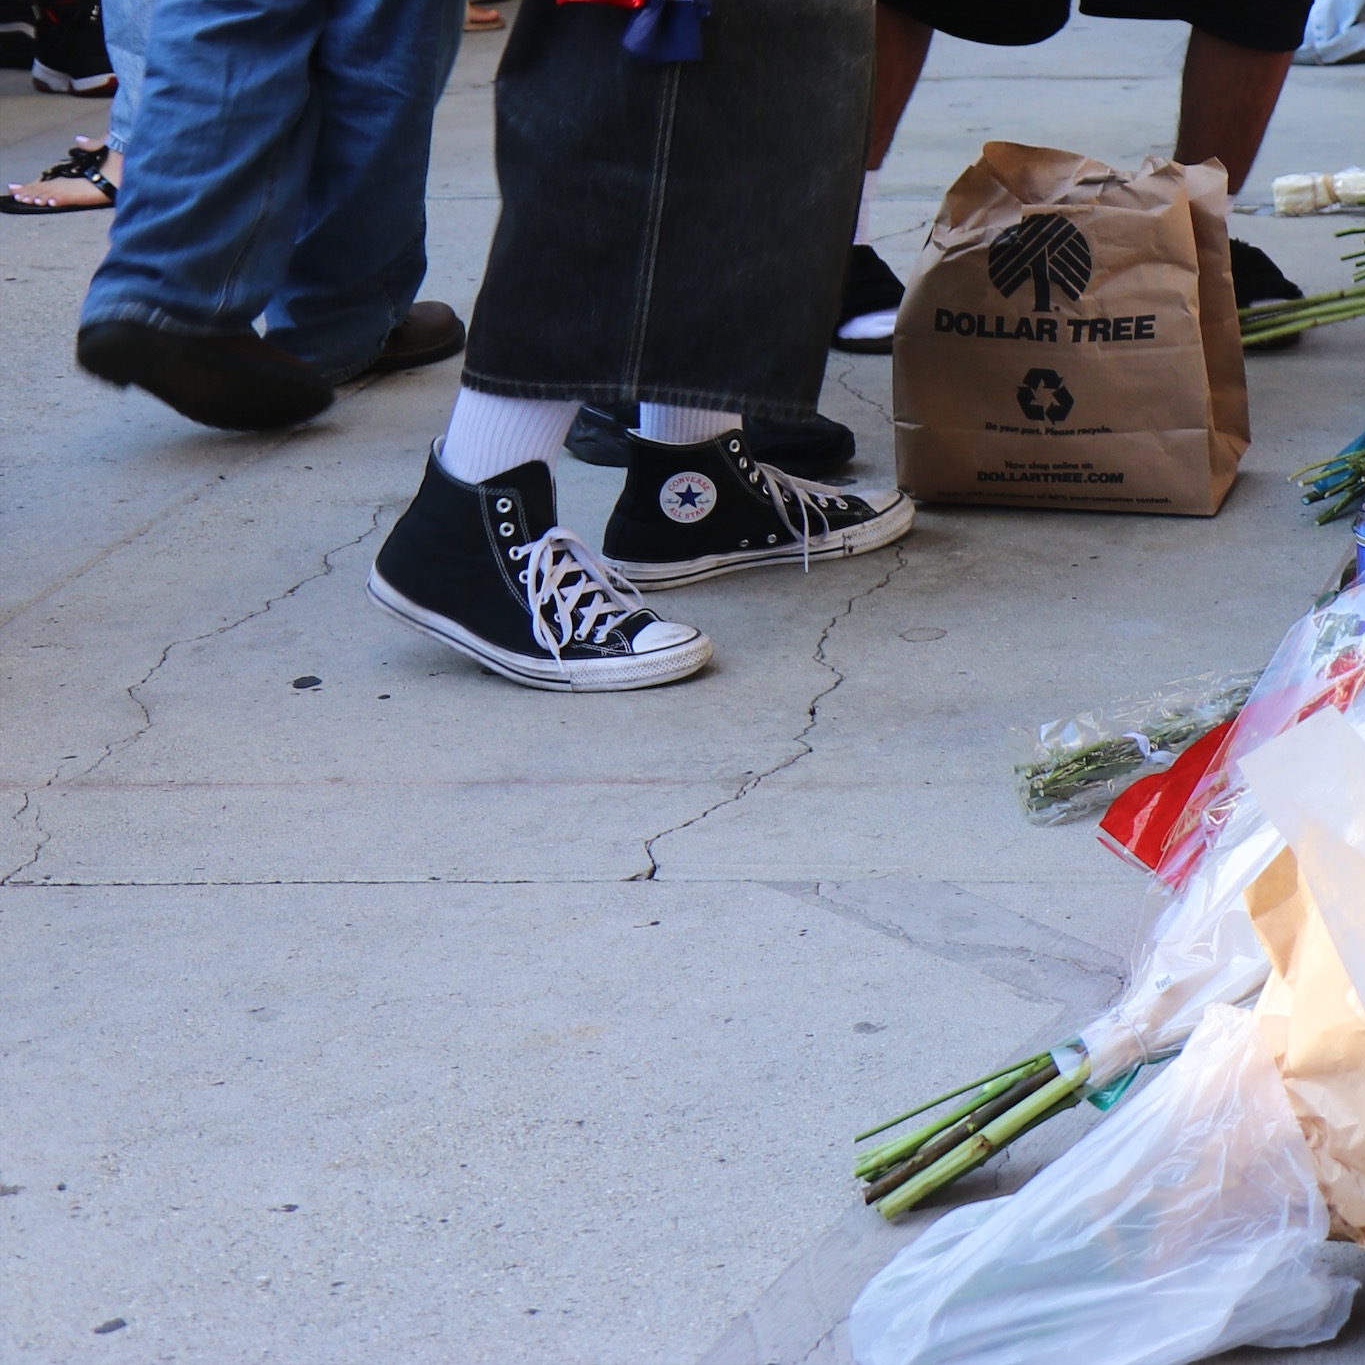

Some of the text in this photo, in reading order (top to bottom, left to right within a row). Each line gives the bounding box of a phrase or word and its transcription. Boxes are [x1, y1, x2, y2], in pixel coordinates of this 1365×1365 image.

[934, 308, 1156, 343] DOLLAR TREE
[985, 422, 1113, 436] Do your part. Please recycle.
[1005, 461, 1026, 470] Now
[1028, 461, 1050, 471] shop
[1052, 462, 1079, 470] online
[668, 476, 711, 492] CONVERSE
[977, 471, 1124, 484] DOLLARTREE.COM
[1070, 495, 1134, 504] post-consumer
[1136, 496, 1172, 505] content.
[669, 507, 706, 519] ALL STAR
